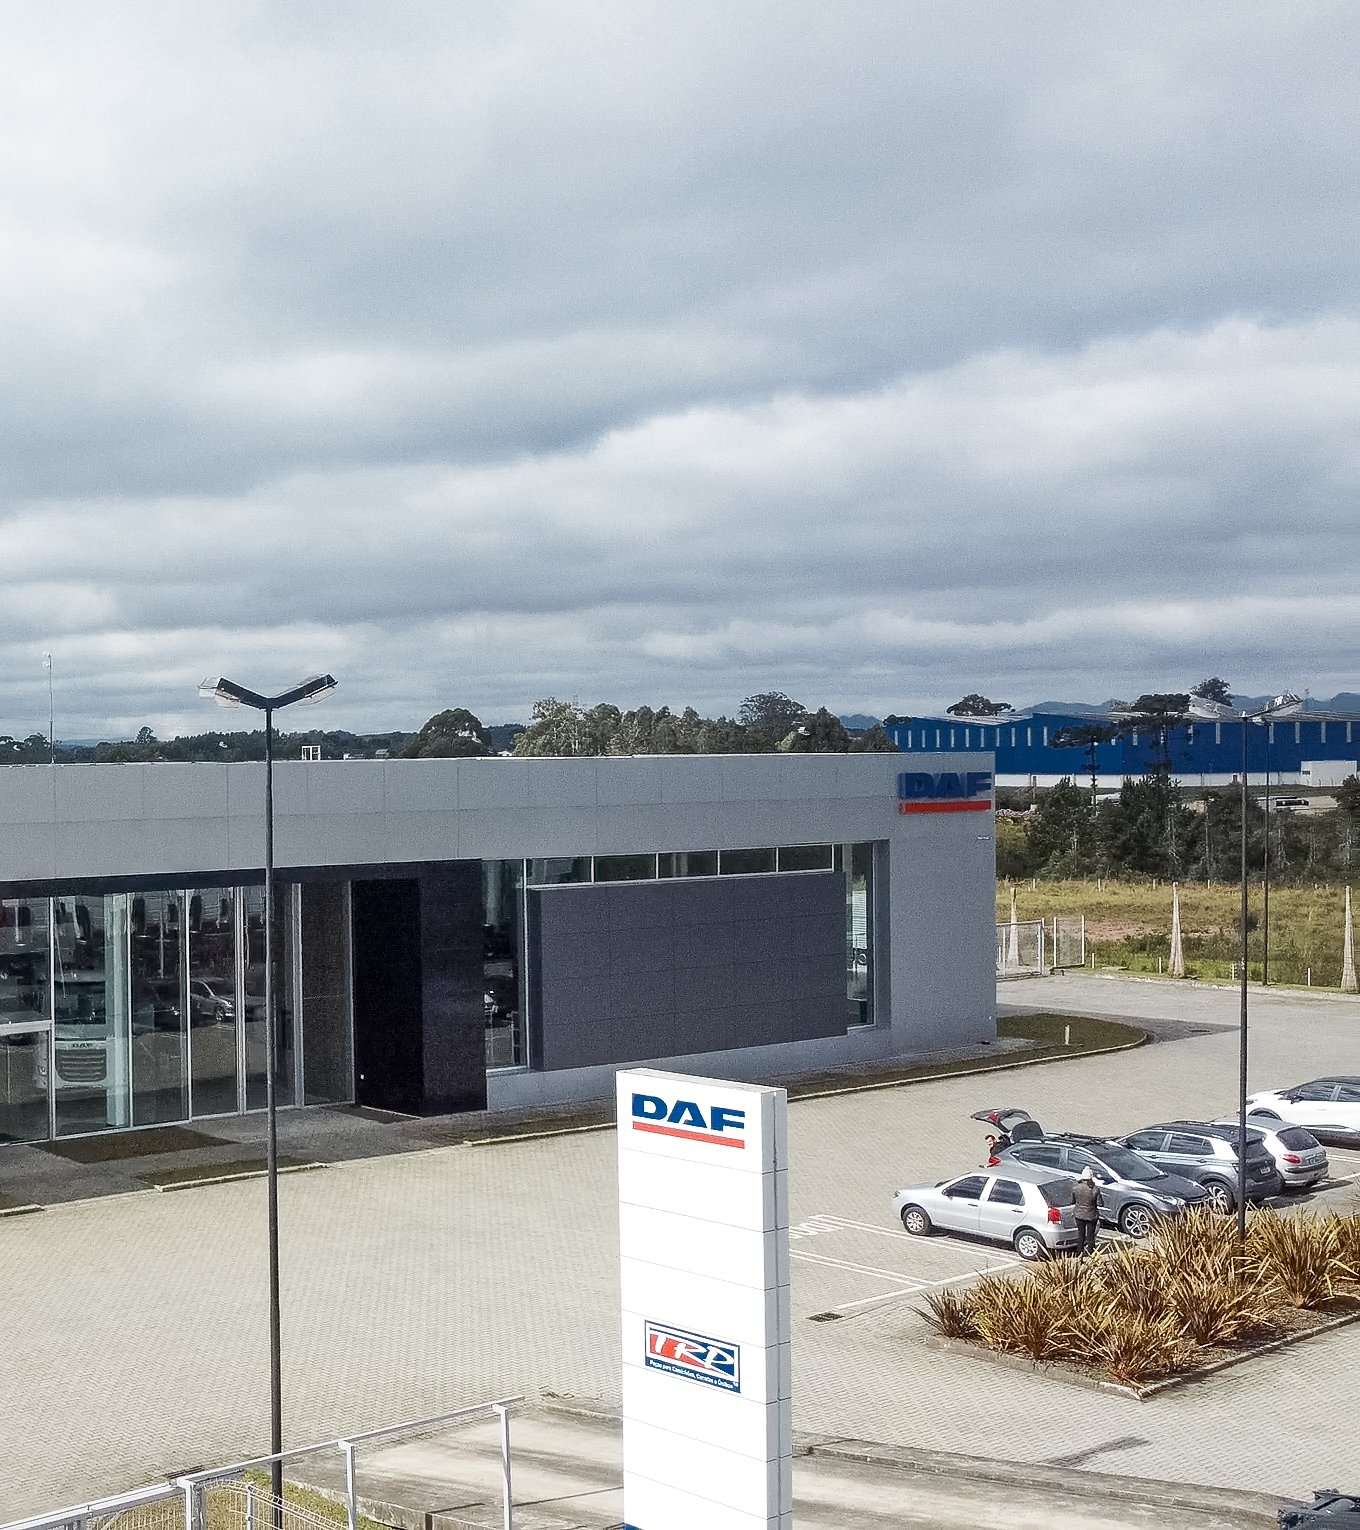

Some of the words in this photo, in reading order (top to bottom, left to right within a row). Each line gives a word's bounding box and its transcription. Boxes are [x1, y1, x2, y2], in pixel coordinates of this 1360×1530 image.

[898, 771, 992, 799] DAF
[631, 1092, 746, 1132] DAF
[648, 1328, 735, 1372] TRP
